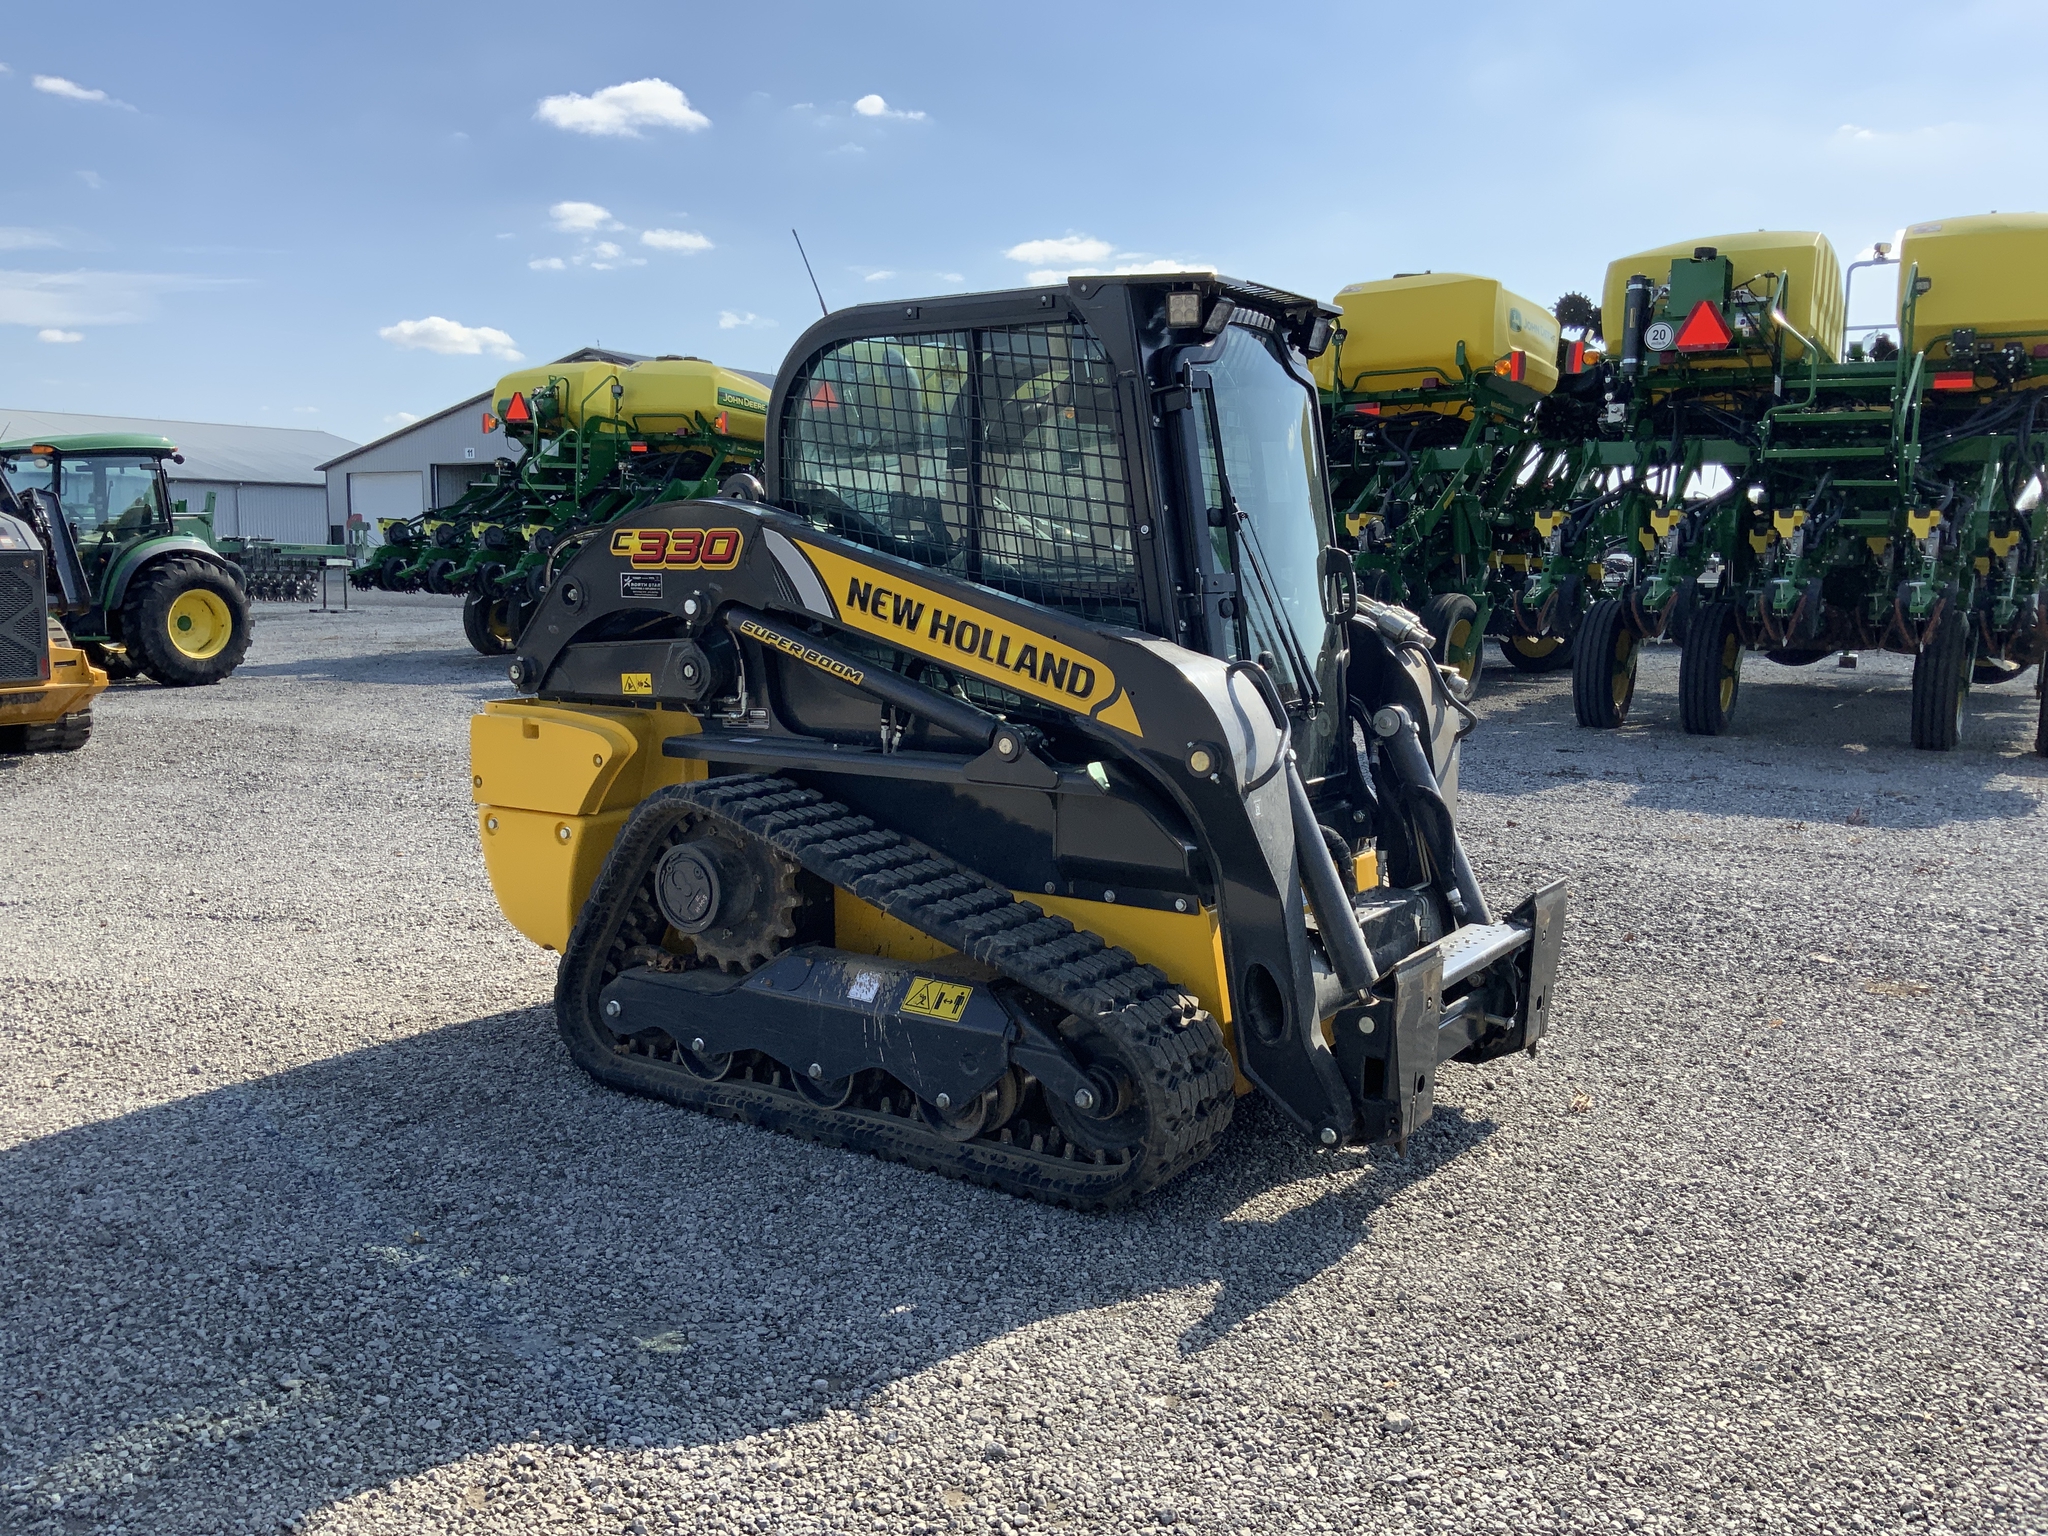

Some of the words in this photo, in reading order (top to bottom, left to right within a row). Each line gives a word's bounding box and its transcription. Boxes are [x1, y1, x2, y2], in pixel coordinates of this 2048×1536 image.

[1652, 329, 1666, 341] 20
[722, 392, 744, 406] JOHN
[743, 397, 766, 412] DEERE
[467, 449, 473, 458] 11
[611, 530, 741, 565] C330
[846, 576, 925, 632] NEW
[928, 608, 1095, 699] HOLLAND
[741, 621, 803, 657] SUPER
[804, 649, 864, 684] BOOM
